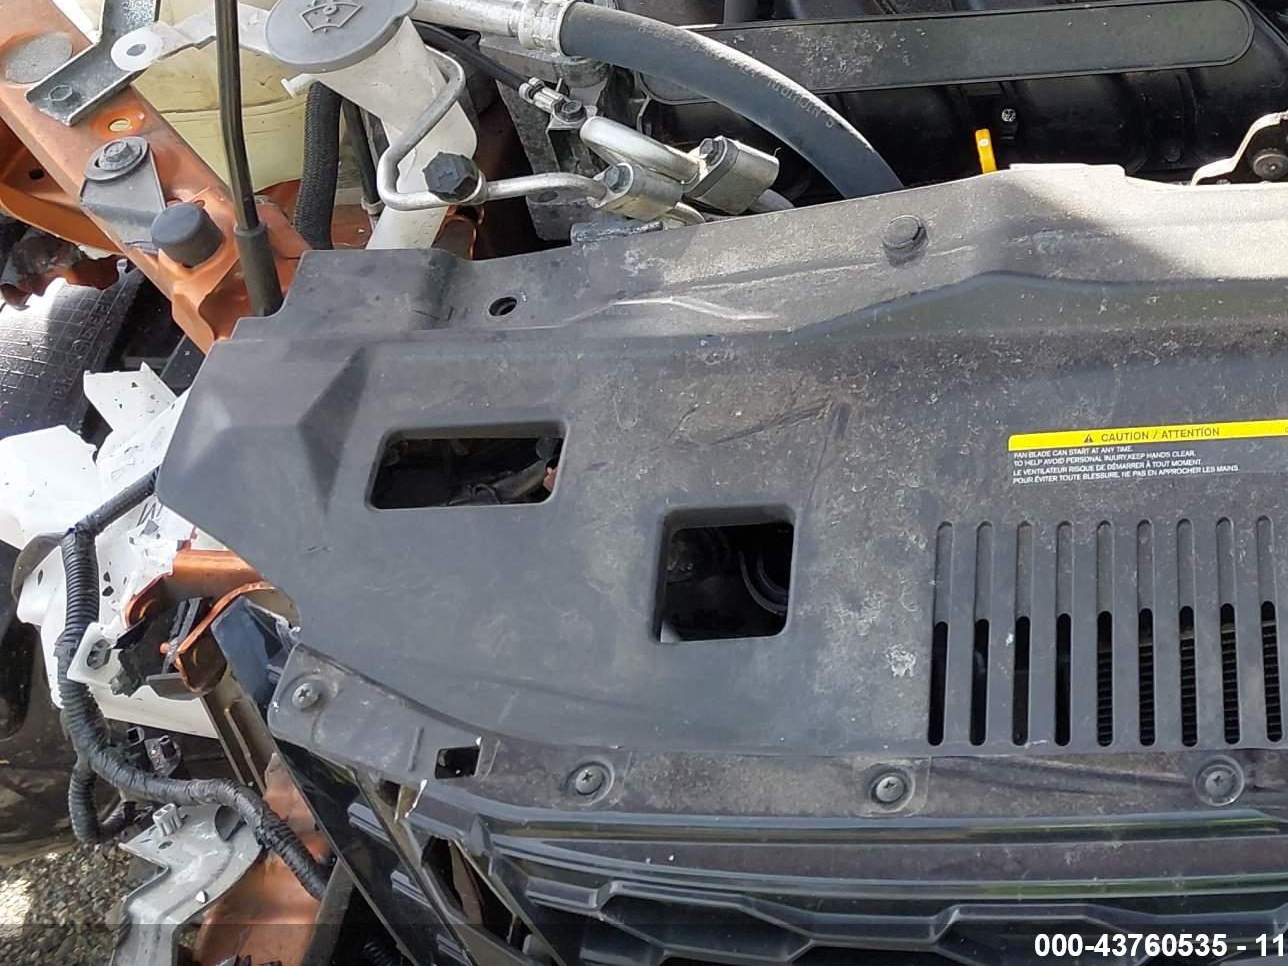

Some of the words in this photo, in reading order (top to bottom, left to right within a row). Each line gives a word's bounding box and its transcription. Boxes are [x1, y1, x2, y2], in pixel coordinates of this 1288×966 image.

[1101, 432, 1149, 442] CAUTION
[1161, 427, 1220, 439] ATTENTION
[1066, 456, 1102, 464] PERSONAL
[1146, 451, 1171, 459] HANDS
[1069, 448, 1090, 456] START
[1023, 466, 1067, 476] VENTILATEUR
[1068, 465, 1095, 473] RISQUE
[1152, 460, 1170, 468] TOUT
[1059, 473, 1081, 481] TOUTE
[1158, 467, 1201, 475] APPROCHER
